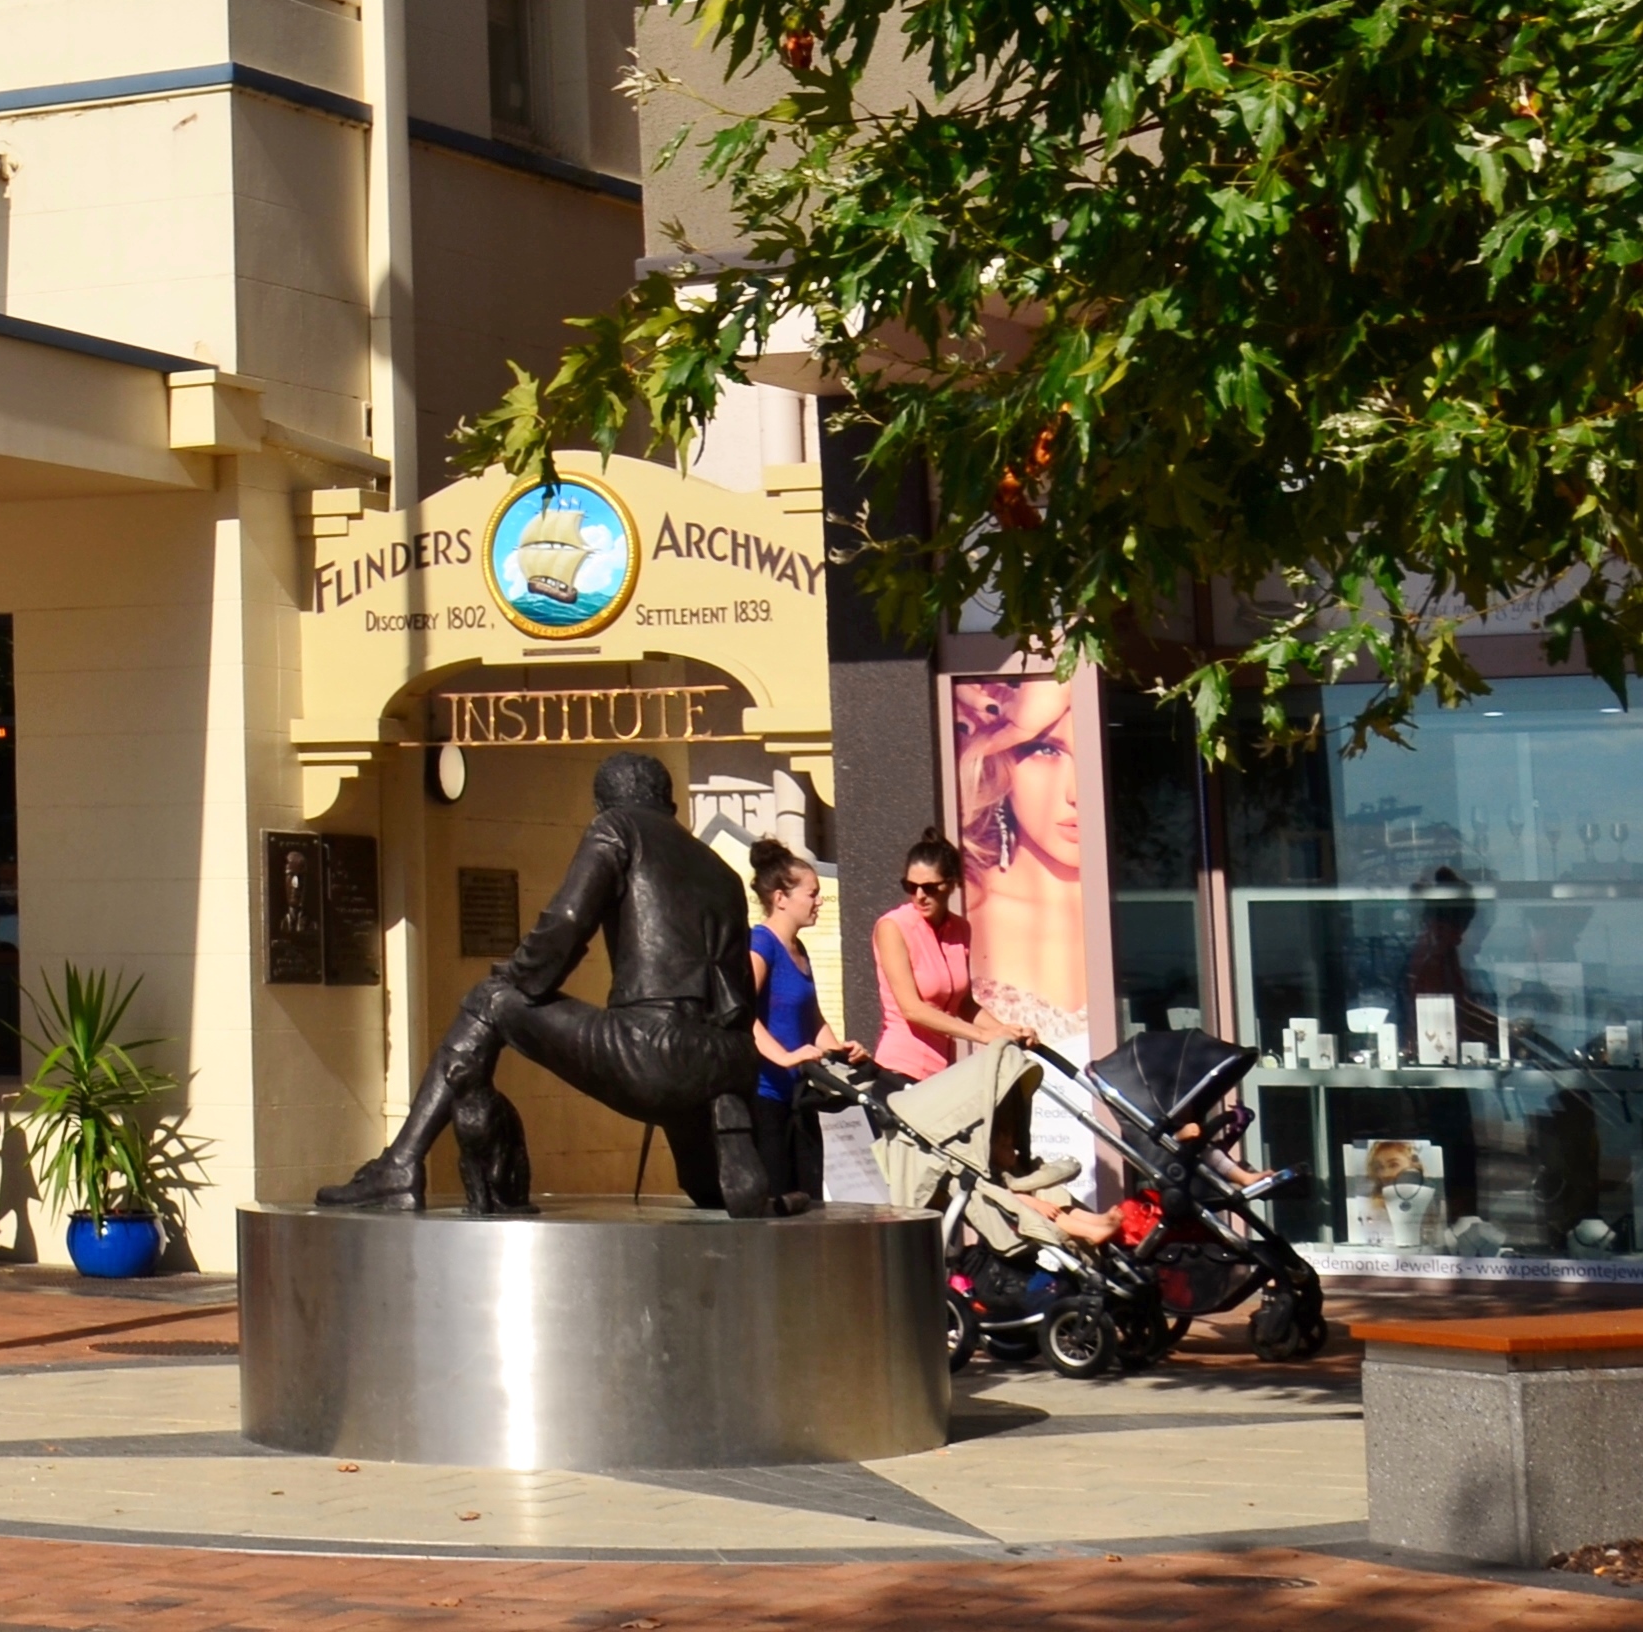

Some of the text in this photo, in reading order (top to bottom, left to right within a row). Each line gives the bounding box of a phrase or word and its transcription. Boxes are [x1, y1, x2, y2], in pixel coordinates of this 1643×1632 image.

[314, 510, 826, 615] FLINDERS ARCHWAY
[449, 690, 713, 743] INSTITUTE
[1305, 1254, 1390, 1272] Pedemonte
[1393, 1258, 1464, 1275] Jewellers
